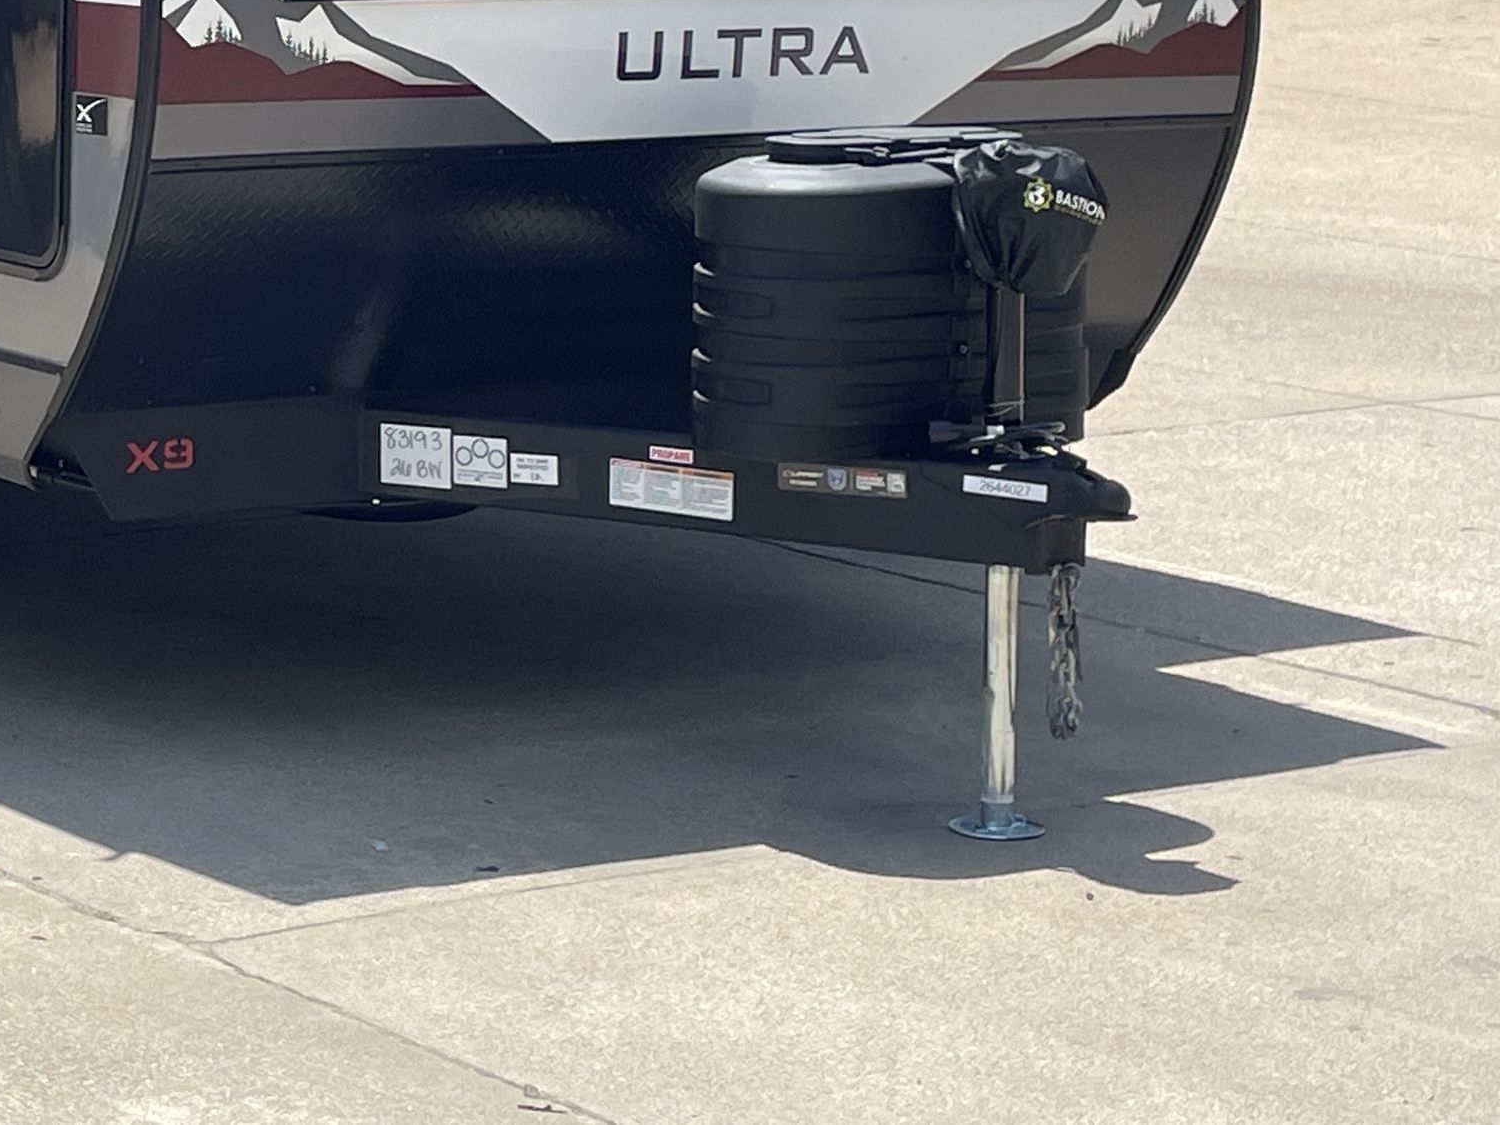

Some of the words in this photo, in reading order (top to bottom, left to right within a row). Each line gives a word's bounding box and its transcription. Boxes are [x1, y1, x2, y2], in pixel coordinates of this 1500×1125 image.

[616, 25, 869, 81] ULTRA
[125, 437, 194, 474] X9
[384, 426, 444, 452] 83193
